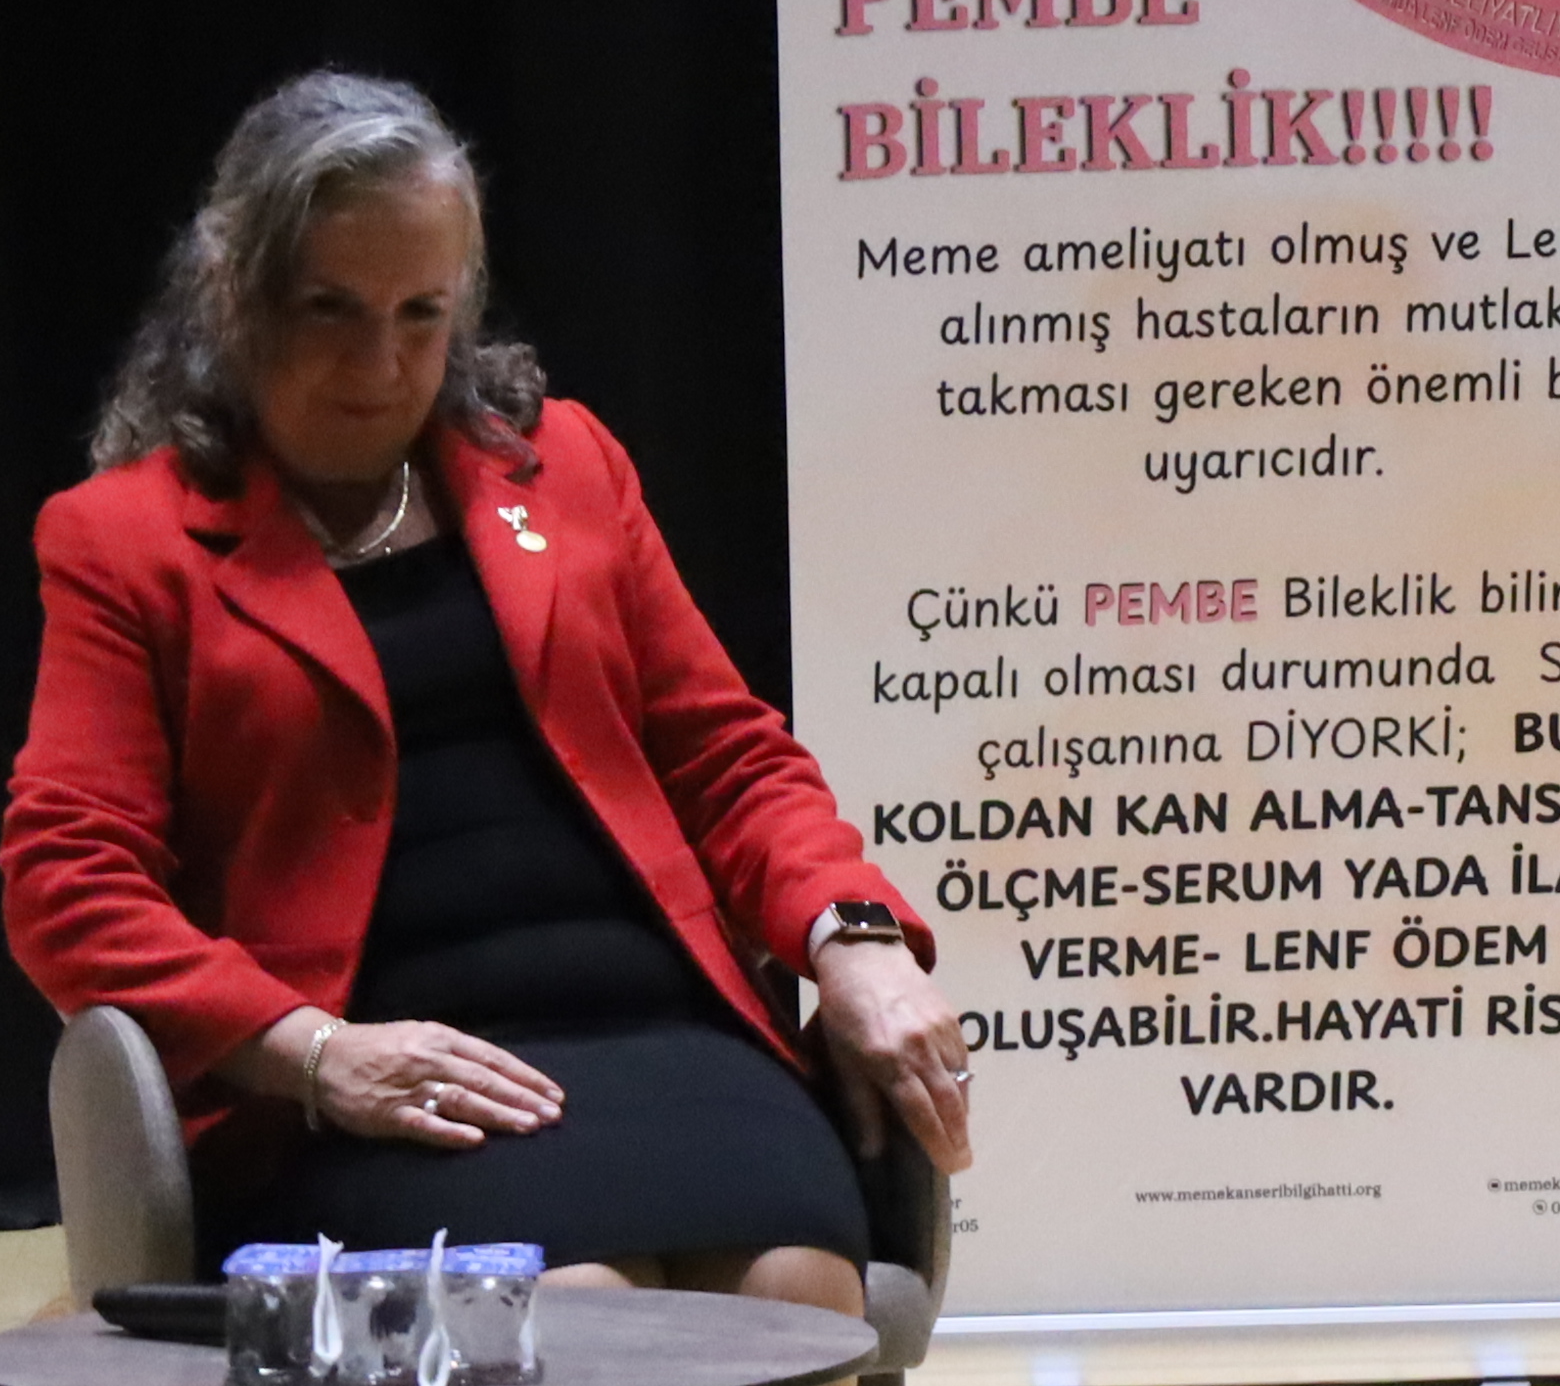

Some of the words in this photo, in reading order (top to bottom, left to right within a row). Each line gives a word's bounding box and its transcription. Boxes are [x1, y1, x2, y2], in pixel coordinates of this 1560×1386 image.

[836, 68, 1493, 182] BİLEKLİK!!!!!
[857, 237, 999, 279] Meme
[1024, 226, 1245, 283] ameliyatı
[1271, 220, 1408, 275] olmuş
[1431, 230, 1480, 262] ve
[940, 301, 1110, 354] alınmış
[1137, 293, 1379, 340] hastaların
[937, 373, 1128, 417] takması
[1154, 370, 1341, 424] gereken
[1367, 358, 1521, 405] önemli
[1144, 433, 1383, 496] uyarıcıdır.
[907, 584, 1058, 643] Çünkü
[1084, 578, 1258, 626] PEMBE
[1285, 572, 1456, 618] Bileklik
[873, 655, 1018, 711] kapalı
[1044, 652, 1195, 697] olması
[1221, 642, 1495, 692] durumunda
[977, 725, 1222, 780] çalışanına
[1247, 708, 1466, 764] DİYORKİ;
[874, 796, 1093, 846] KOLDAN
[1117, 792, 1228, 837] KAN
[936, 858, 1322, 922] ÖLÇME-SERUM
[1344, 854, 1489, 900] YADA
[1020, 934, 1220, 980] VERME-
[1245, 929, 1371, 973] LENF
[1393, 915, 1547, 969] ÖDEM
[958, 985, 1463, 1062] OLUŞABİLİR.HAYATİ
[1180, 1069, 1394, 1116] VARDIR.
[1135, 1183, 1382, 1203] www.memekanseribilgihatti.org
[1551, 1201, 1560, 1214] 0
